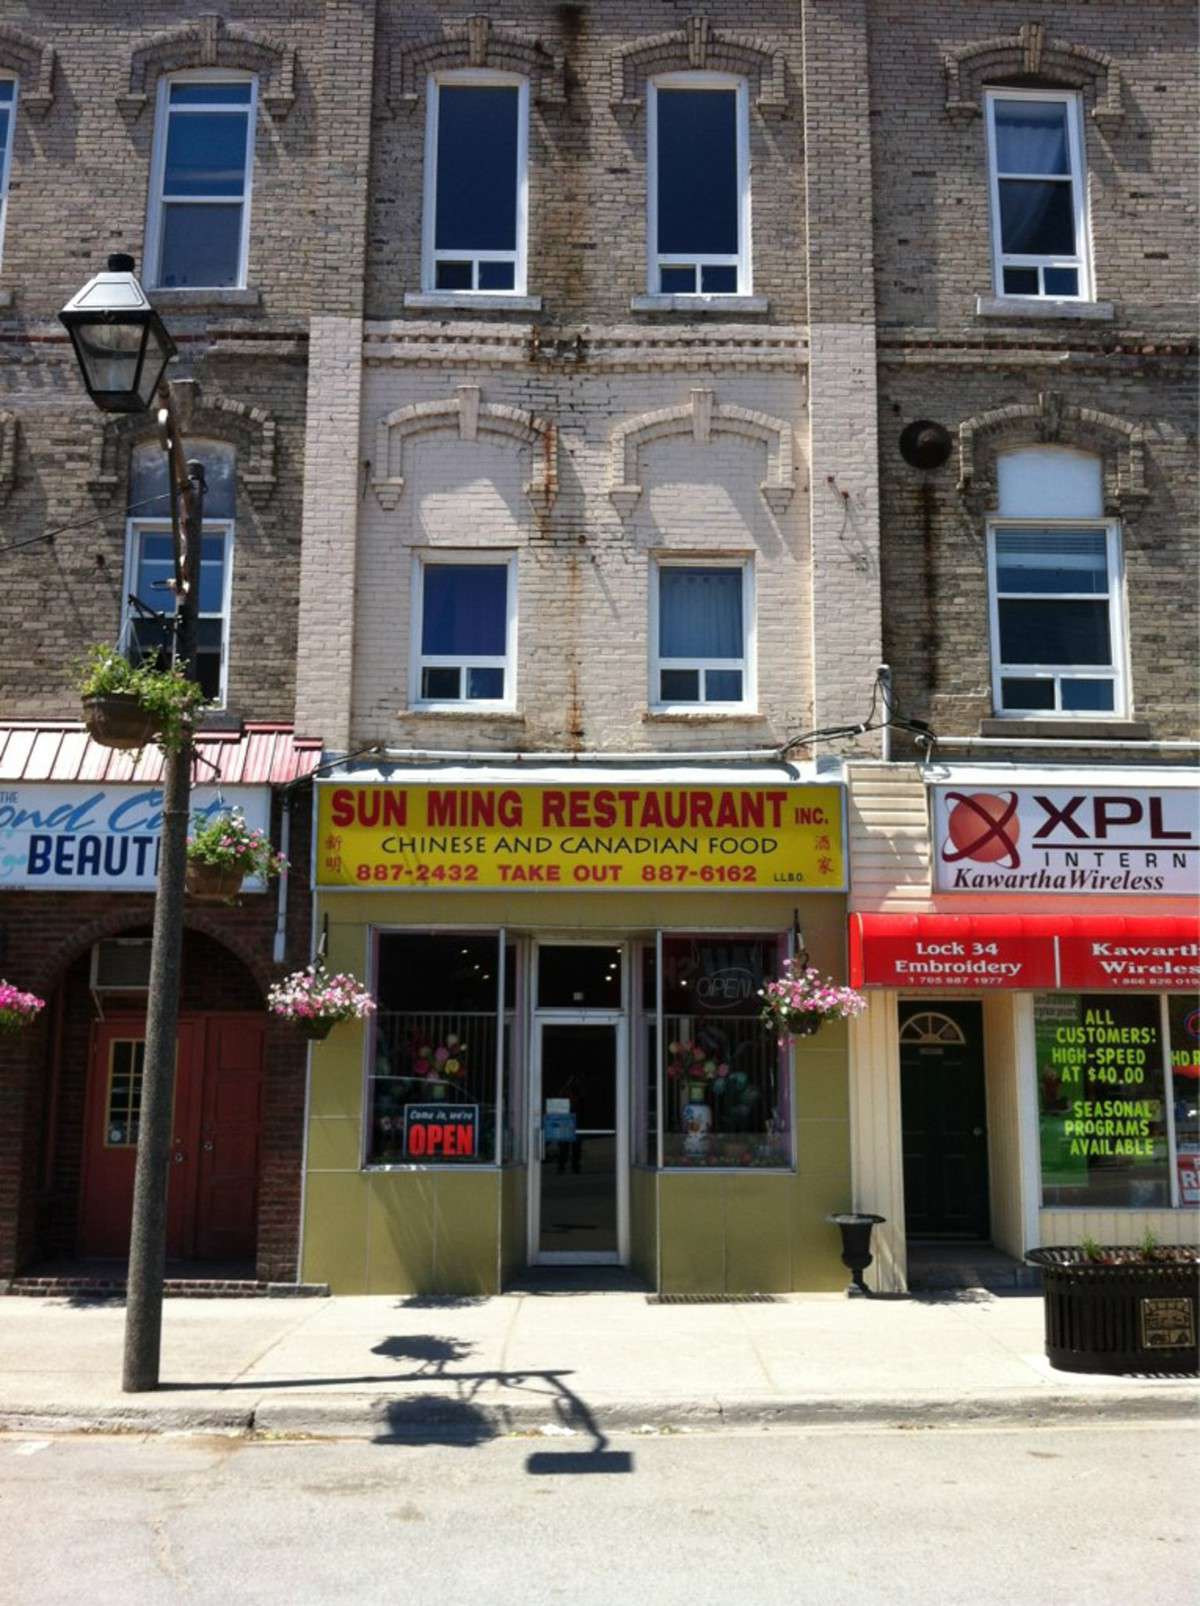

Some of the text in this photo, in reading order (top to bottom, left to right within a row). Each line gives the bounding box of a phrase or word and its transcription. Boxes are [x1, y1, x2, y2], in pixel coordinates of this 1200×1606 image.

[331, 789, 829, 829] SUN MING RESTAURANT INC.
[1032, 796, 1192, 840] XPL
[382, 836, 778, 855] CHINESE AND CANADIAN FOOD
[26, 834, 160, 877] BEAUT
[1044, 852, 1188, 869] INTERN
[356, 864, 757, 883] 887-2432 TAKE OUT 887-6162
[915, 942, 999, 956] Lock 34
[894, 960, 1022, 977] Embroidery
[697, 977, 753, 998] OPEN
[1085, 1009, 1115, 1026] ALL
[1052, 1048, 1146, 1065] HIGH-SPEED
[1062, 1067, 1144, 1084] AT $40.00
[1074, 1101, 1153, 1118] SEASONAL
[1064, 1121, 1150, 1137] PROGRAMS
[408, 1123, 474, 1157] OPEN
[1070, 1139, 1154, 1156] AVAILABLE
